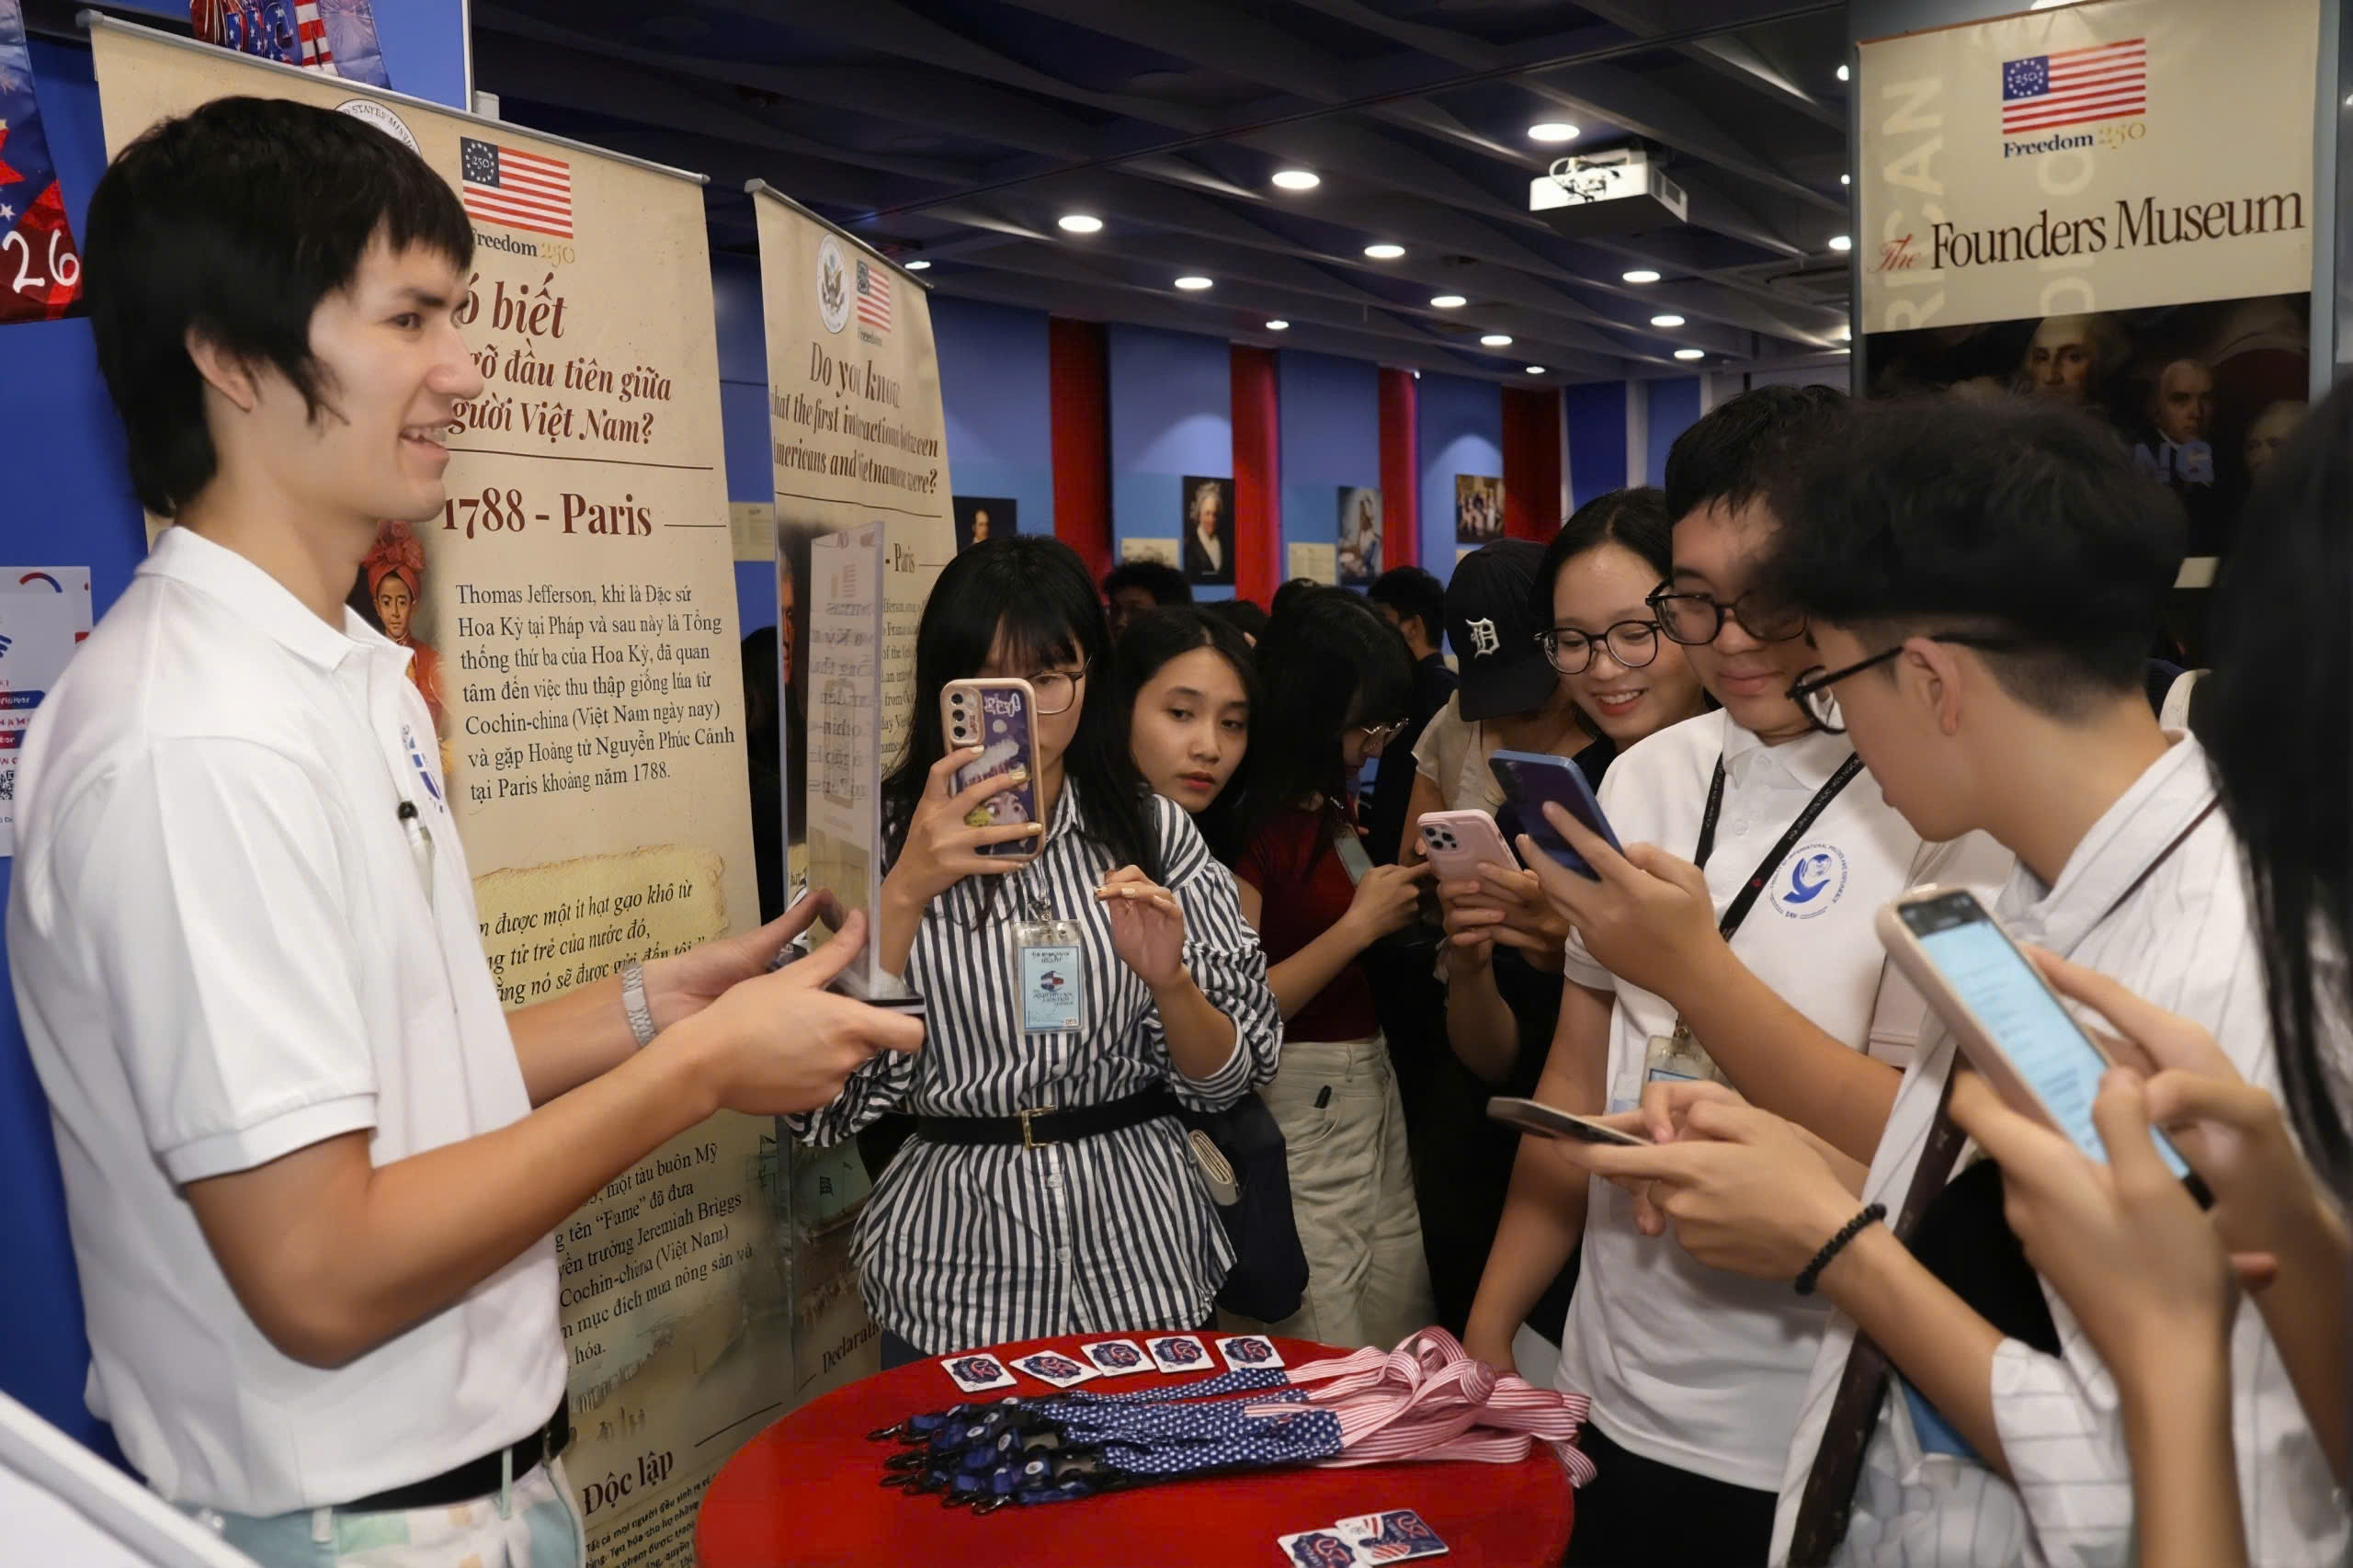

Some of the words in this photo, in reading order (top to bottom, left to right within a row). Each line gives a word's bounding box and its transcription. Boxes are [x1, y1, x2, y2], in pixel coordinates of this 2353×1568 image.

[471, 155, 490, 169] 250
[2003, 134, 2095, 159] Freedom
[2097, 121, 2147, 151] 250
[1870, 233, 1921, 273] The
[1930, 209, 2108, 271] Founders
[2114, 190, 2306, 252] Museum
[492, 272, 568, 339] biết
[505, 337, 555, 387] đầu
[564, 357, 615, 394] tiên
[619, 365, 673, 403] giữa
[810, 341, 832, 386] Do
[448, 392, 513, 435] gười
[520, 401, 576, 444] Việt
[578, 407, 655, 445] Nam?
[793, 392, 813, 426] the
[813, 397, 839, 435] first
[830, 449, 858, 479] and
[442, 486, 527, 540] 1788
[560, 492, 654, 538] Paris
[456, 584, 523, 604] Thomas
[528, 584, 597, 607] Jefferson,
[601, 584, 625, 603] khi
[630, 584, 642, 603] là
[645, 584, 671, 606] Đặc
[676, 585, 691, 602] sứ
[458, 617, 494, 637] Hoa
[500, 616, 523, 641] Kỳ
[529, 615, 545, 639] tại
[549, 615, 585, 640] Pháp
[589, 615, 608, 633] và
[612, 619, 636, 633] sau
[641, 614, 663, 637] này
[667, 613, 679, 631] là
[683, 608, 722, 635] Tổng
[460, 644, 510, 673] thống
[515, 647, 539, 667] thứ
[541, 647, 558, 666] ba
[562, 646, 587, 665] của
[592, 645, 624, 664] Hoa
[628, 643, 654, 667] Kỳ,
[656, 643, 672, 661] đã
[676, 646, 710, 665] quan
[463, 683, 497, 702] tâm
[501, 675, 529, 699] đến
[534, 677, 561, 701] việc
[565, 677, 588, 696] thu
[593, 676, 625, 699] thập
[631, 668, 669, 698] giống
[672, 671, 692, 689] lúa
[696, 670, 711, 688] từ
[465, 710, 569, 735] Cochin-china
[573, 706, 609, 732] (Việt
[613, 704, 650, 724] Nam
[654, 701, 684, 724] ngày
[688, 699, 721, 721] nay)
[468, 748, 490, 768] và
[494, 746, 524, 771] gặp
[529, 742, 574, 764] Hoàng
[577, 738, 592, 757] tử
[596, 729, 655, 759] Nguyễn
[659, 730, 691, 750] Phúc
[695, 726, 736, 746] Cảnh
[471, 779, 493, 805] tại
[498, 775, 539, 799] Paris
[542, 770, 592, 793] khoảng
[595, 767, 629, 787] năm
[633, 760, 671, 782] 1788.
[494, 912, 539, 935] được
[543, 903, 571, 926] một
[575, 899, 585, 919] ít
[589, 895, 609, 917] hạt
[614, 892, 642, 916] gạo
[647, 882, 674, 904] khô
[678, 879, 693, 899] từ
[511, 943, 529, 966] tử
[533, 937, 555, 961] trẻ
[560, 932, 585, 956] của
[589, 924, 623, 949] nước
[627, 917, 651, 940] đó,
[531, 971, 551, 995] nó
[556, 968, 573, 990] sẽ
[575, 962, 609, 984] được
[607, 1176, 632, 1199] một
[635, 1168, 654, 1186] tàu
[657, 1154, 692, 1177] buôn
[696, 1142, 719, 1169] Mỹ
[569, 1221, 593, 1243] tên
[596, 1196, 646, 1230] “Fame”
[649, 1190, 665, 1210] đã
[668, 1182, 694, 1202] đưa
[588, 1237, 634, 1267] trưởng
[637, 1207, 694, 1246] Jeremiah
[698, 1194, 743, 1220] Briggs
[655, 1244, 688, 1272] (Việt
[691, 1222, 729, 1252] Nam)
[577, 1307, 610, 1332] mục
[613, 1287, 643, 1317] đích
[646, 1279, 672, 1302] mua
[676, 1264, 709, 1290] nông
[711, 1251, 733, 1272] sản
[736, 1242, 753, 1262] và
[574, 1340, 607, 1365] hóa.
[582, 1471, 633, 1517] Độc
[637, 1450, 674, 1487] lập
